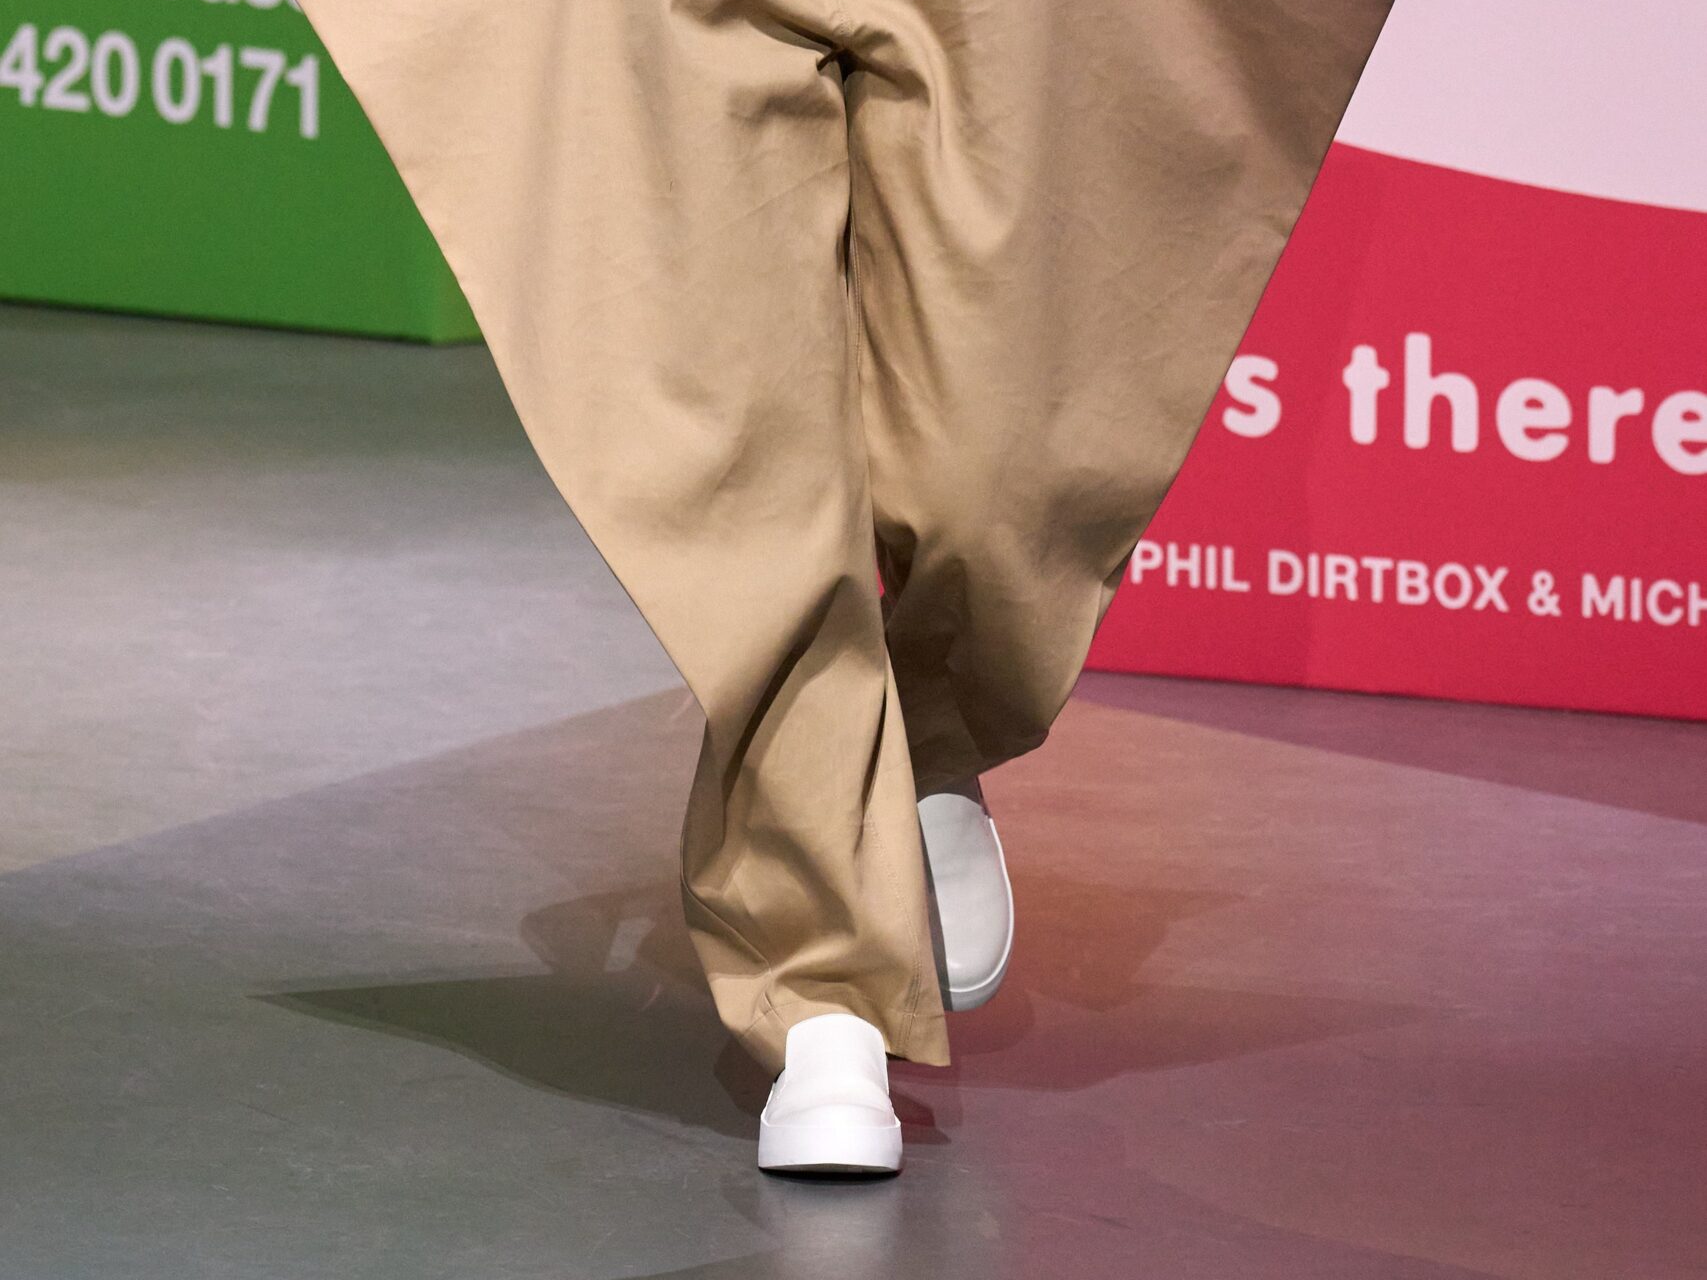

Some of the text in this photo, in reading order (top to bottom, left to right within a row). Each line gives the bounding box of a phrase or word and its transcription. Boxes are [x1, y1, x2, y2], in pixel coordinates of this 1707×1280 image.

[0, 24, 319, 139] 420 0171
[1342, 331, 1707, 476] there
[1129, 538, 1251, 593] PHIL
[1267, 548, 1509, 613] DIRTBOX
[1526, 569, 1562, 617] &
